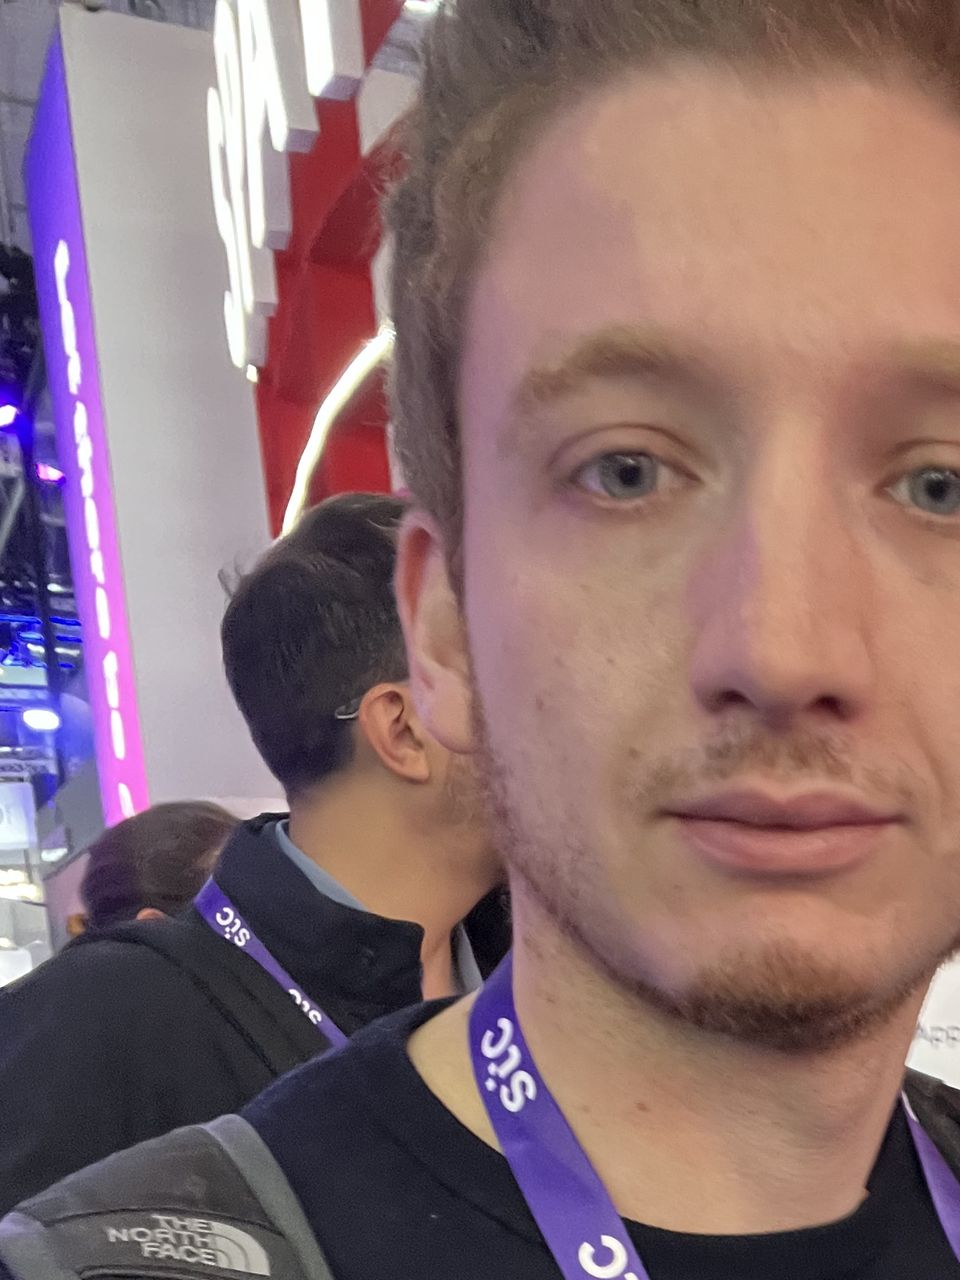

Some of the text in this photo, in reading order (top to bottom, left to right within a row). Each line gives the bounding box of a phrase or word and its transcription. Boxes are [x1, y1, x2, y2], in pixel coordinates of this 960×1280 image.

[215, 907, 250, 947] stc
[480, 1017, 537, 1113] stc
[152, 1214, 213, 1234] THE
[106, 1227, 211, 1249] NORTH
[142, 1241, 217, 1266] FACE
